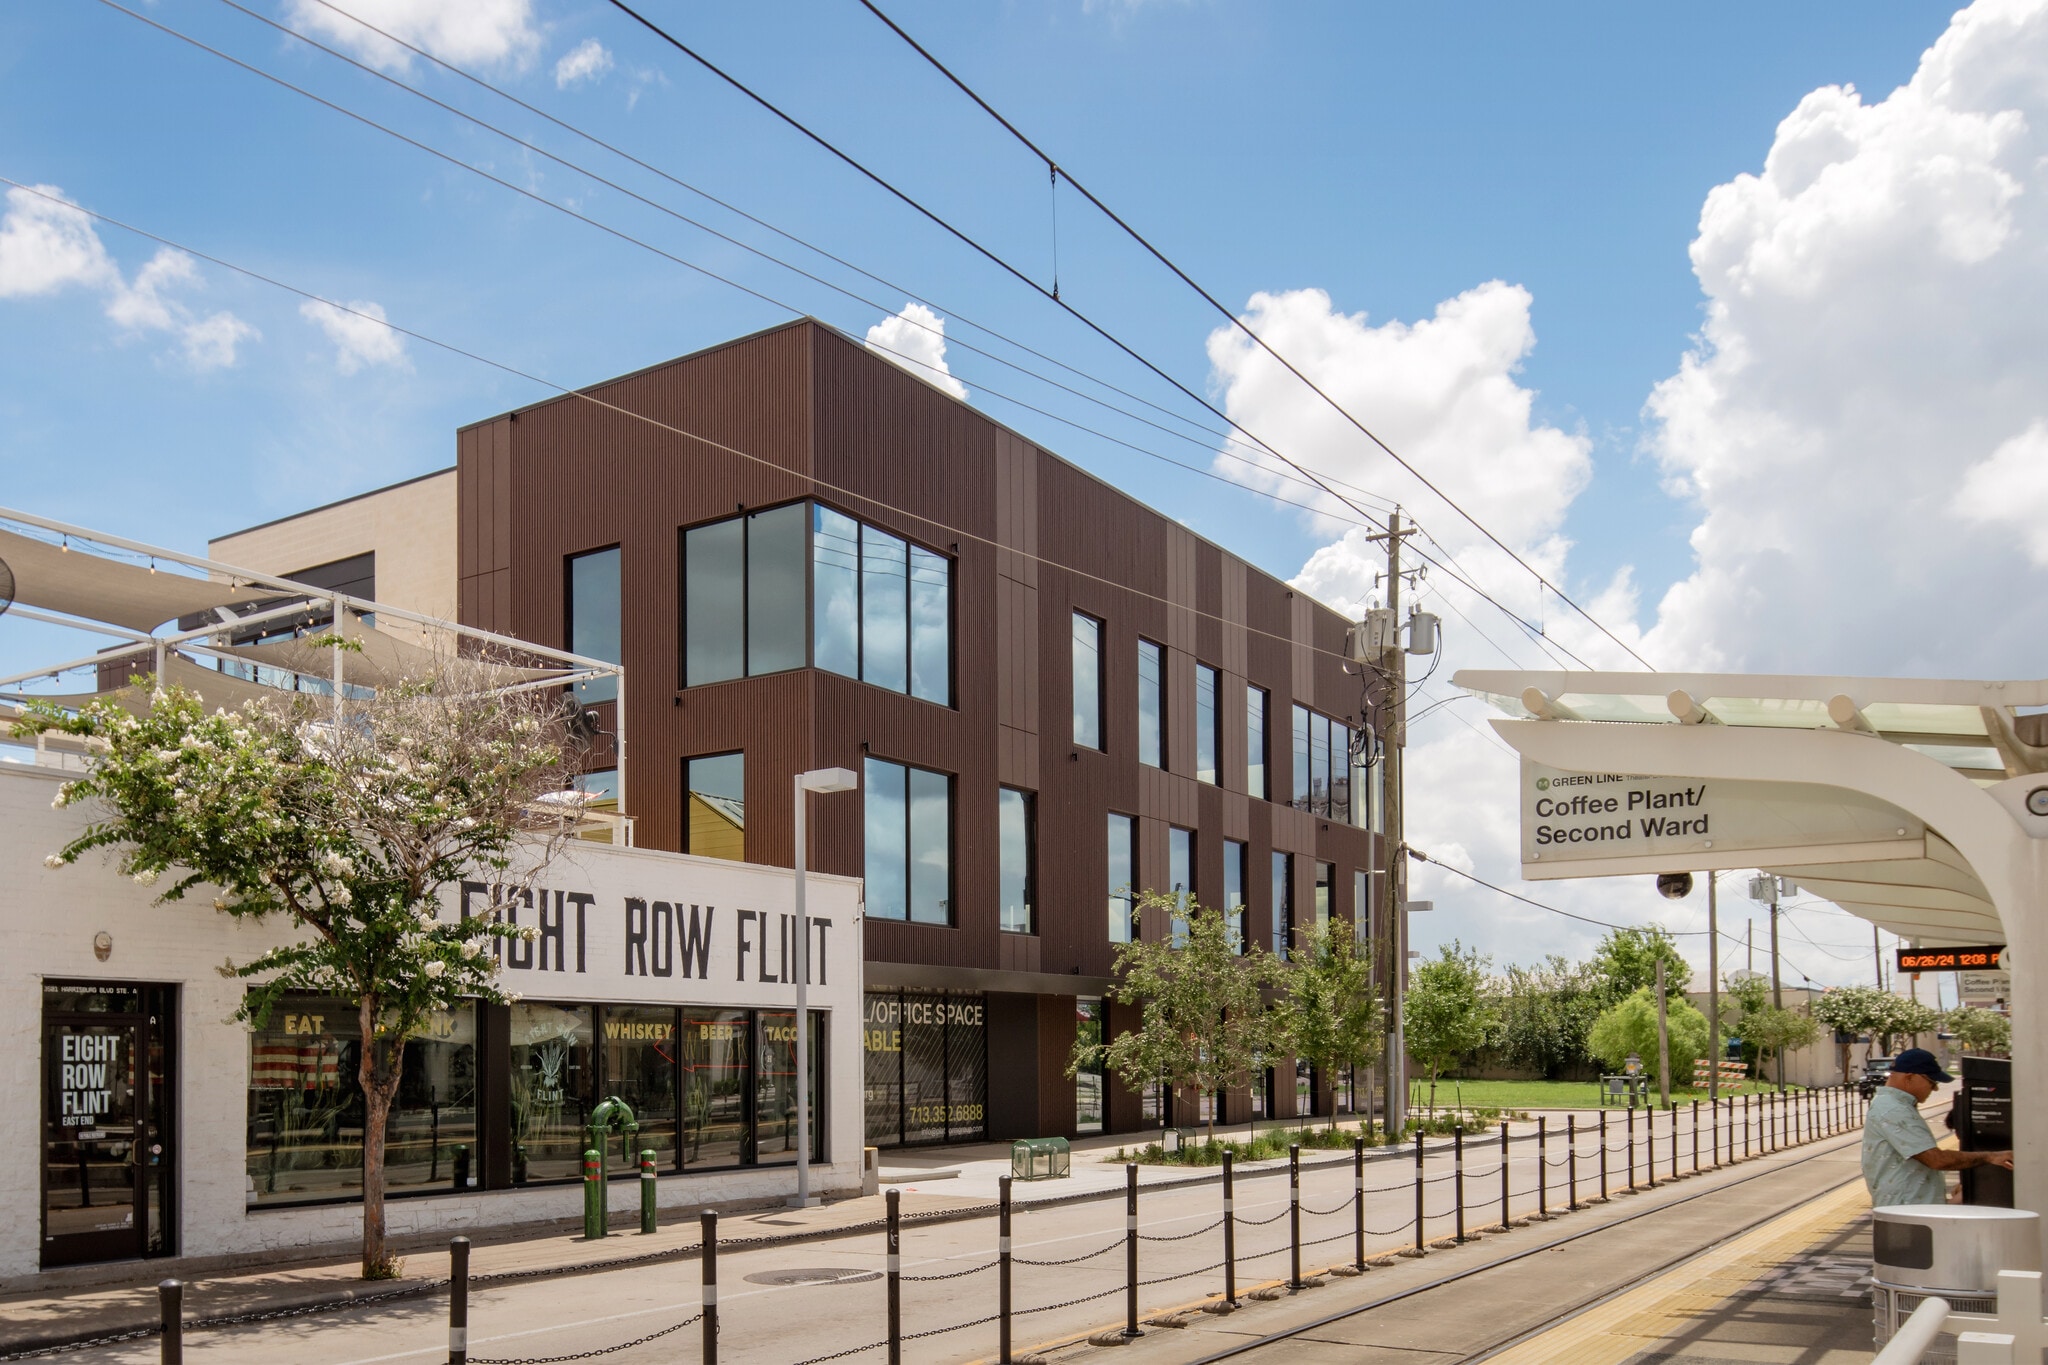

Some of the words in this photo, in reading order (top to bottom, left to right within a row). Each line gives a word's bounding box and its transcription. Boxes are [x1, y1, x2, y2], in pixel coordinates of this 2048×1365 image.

[1552, 775, 1593, 787] GREEN
[1596, 774, 1624, 784] LINE
[1535, 795, 1619, 818] Coffee
[1627, 785, 1706, 811] Plant/
[1536, 820, 1631, 845] Second
[1640, 814, 1709, 838] Ward
[624, 896, 714, 980] ROW
[1901, 954, 1955, 967] 06/26/24
[150, 1016, 156, 1025] A
[935, 1003, 983, 1026] SPACE
[284, 1015, 324, 1035] EAT
[604, 1022, 672, 1040] WHISKEY
[700, 1024, 734, 1041] BEER
[62, 1034, 120, 1062] EIGHT
[62, 1063, 107, 1090] ROW
[62, 1090, 112, 1115] FLINT
[537, 1088, 564, 1102] FLINT
[62, 1116, 79, 1127] EAST
[80, 1115, 94, 1126] END
[909, 1104, 984, 1124] 713.352.6888
